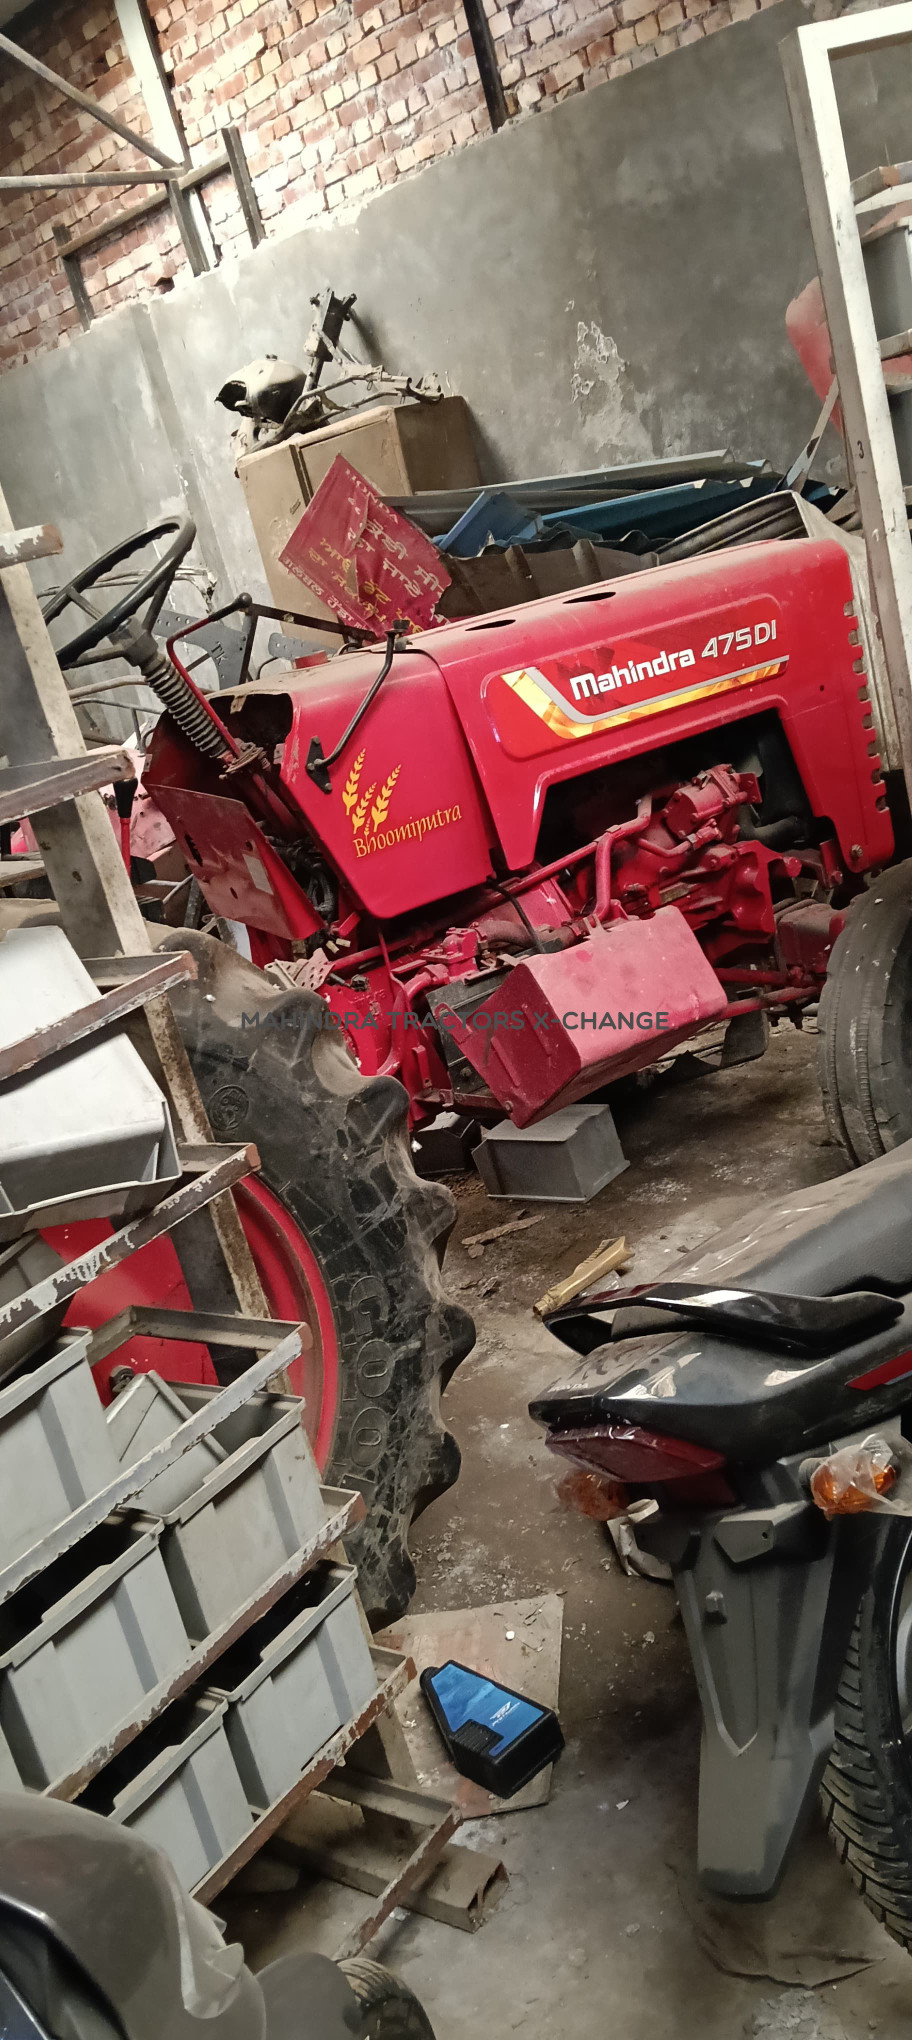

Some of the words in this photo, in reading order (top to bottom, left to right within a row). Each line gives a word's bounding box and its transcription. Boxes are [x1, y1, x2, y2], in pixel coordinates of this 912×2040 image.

[857, 440, 865, 459] 3
[346, 468, 398, 524] HONDA
[569, 648, 696, 701] Mahindra
[352, 804, 463, 859] Bhoomiputra
